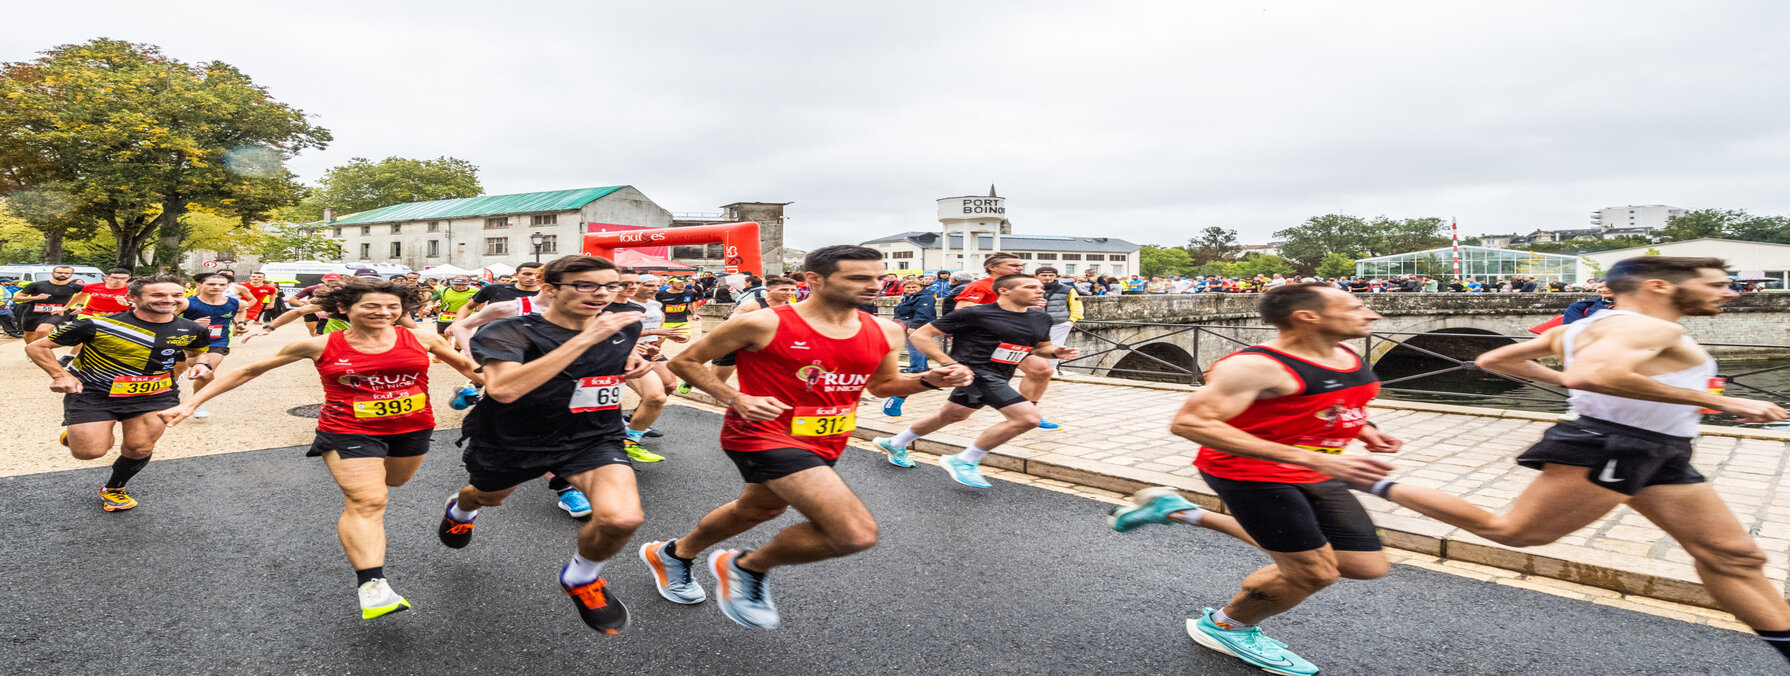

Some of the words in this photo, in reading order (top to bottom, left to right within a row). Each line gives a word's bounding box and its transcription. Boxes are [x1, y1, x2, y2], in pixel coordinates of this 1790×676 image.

[963, 199, 999, 207] PORT
[367, 372, 420, 386] RUN
[824, 374, 871, 386] RUN
[127, 381, 160, 394] 390
[597, 387, 620, 405] 69
[374, 398, 413, 416] 393
[815, 416, 847, 435] 312
